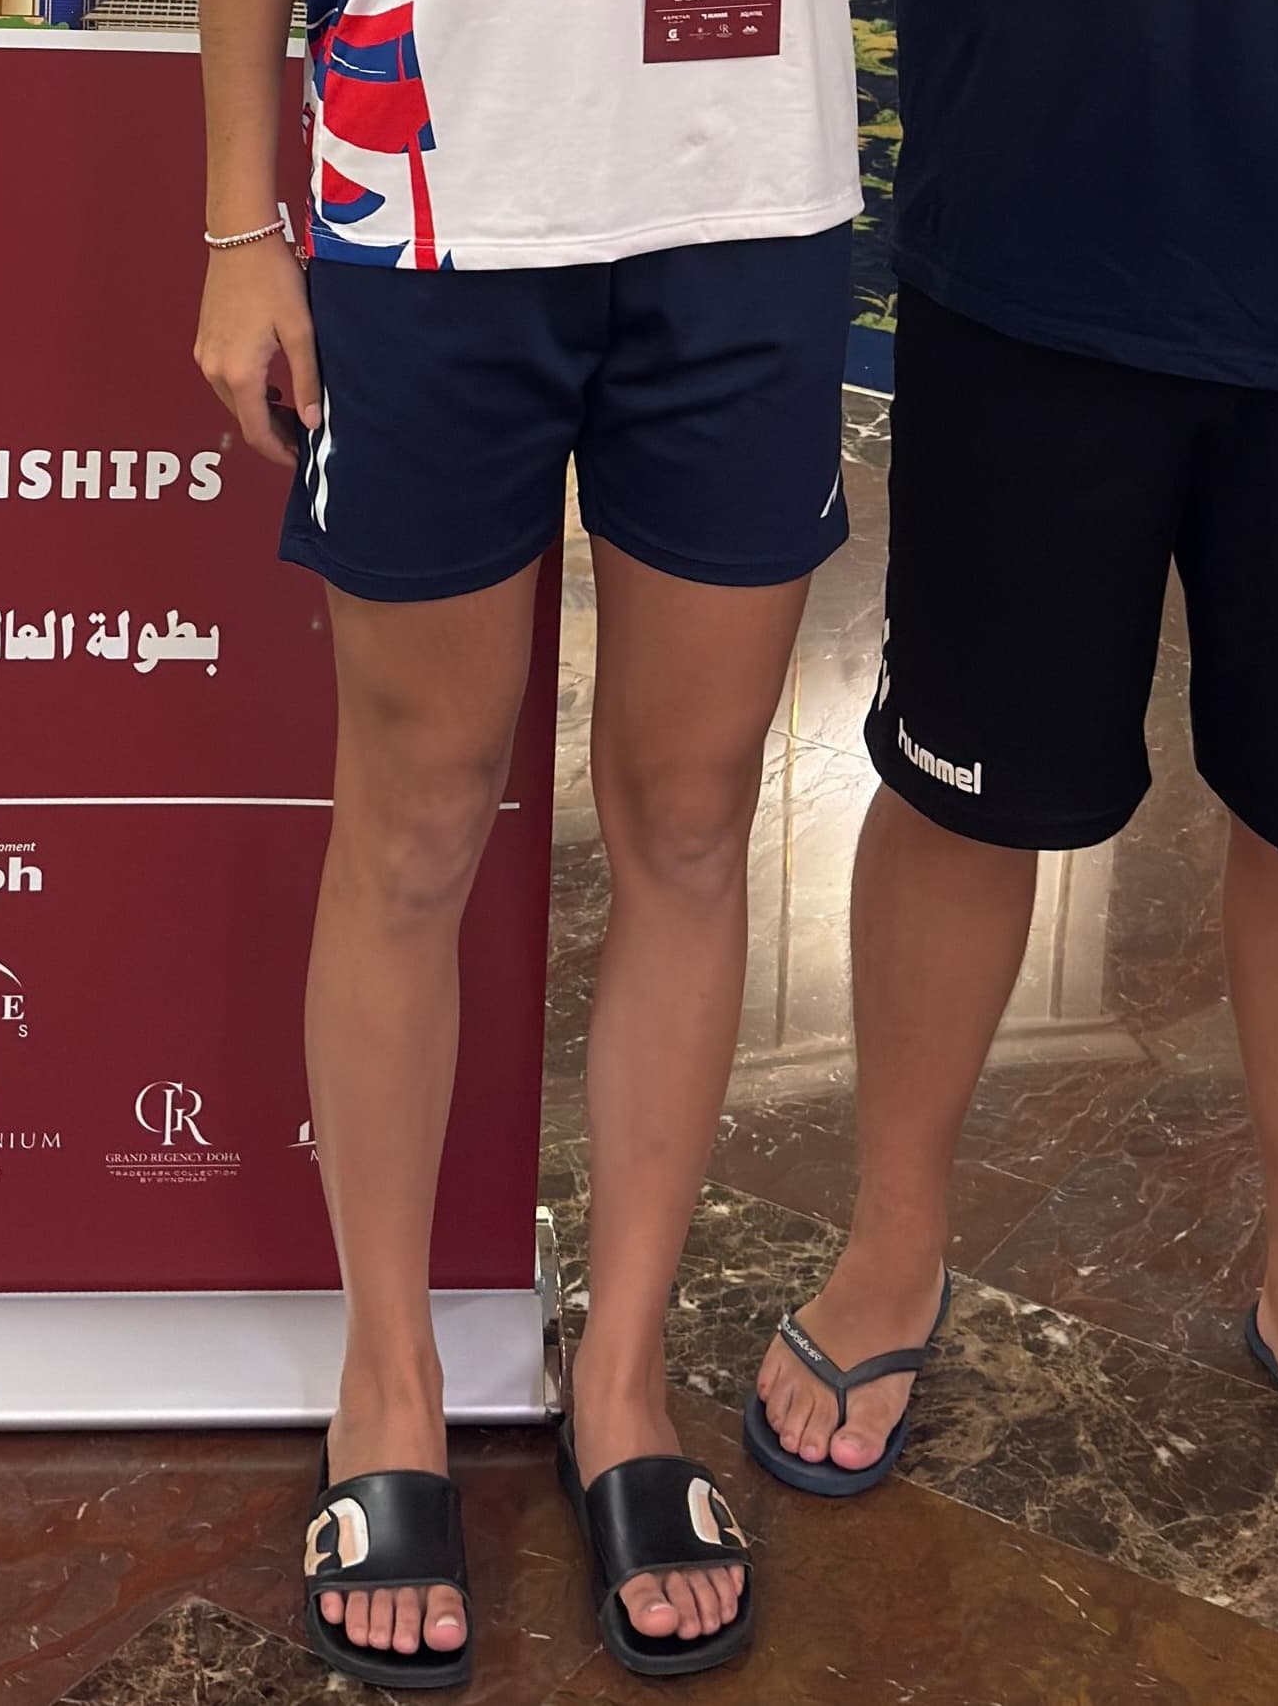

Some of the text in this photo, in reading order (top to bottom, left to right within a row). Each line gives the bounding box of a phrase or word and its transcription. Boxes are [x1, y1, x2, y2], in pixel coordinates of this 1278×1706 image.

[85, 609, 220, 677] بطولة
[897, 717, 982, 795] hummel
[105, 1152, 241, 1163] GRAND REGENCY DOHA
